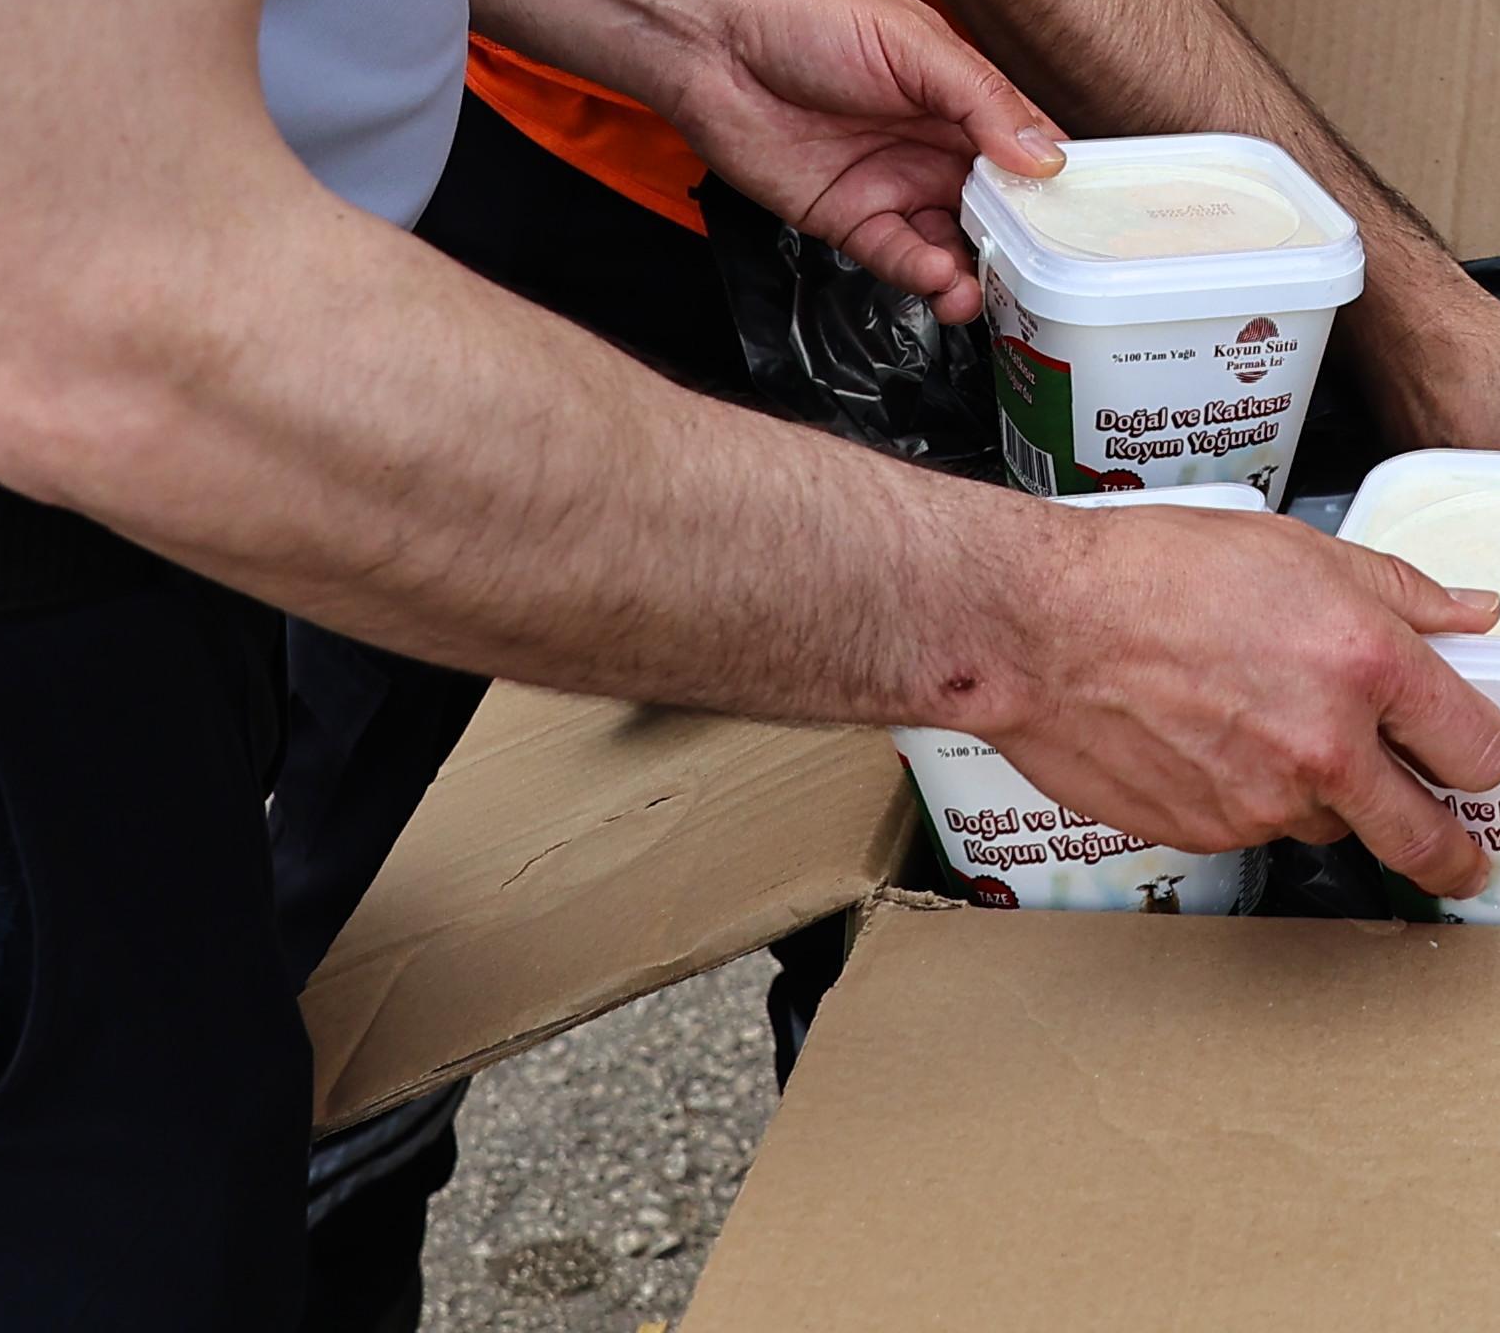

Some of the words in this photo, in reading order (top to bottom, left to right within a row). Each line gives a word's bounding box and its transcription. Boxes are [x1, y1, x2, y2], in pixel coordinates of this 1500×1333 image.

[1111, 352, 1141, 364] %100
[1144, 351, 1168, 362] Tam
[1169, 347, 1197, 362] Yağlı
[1213, 342, 1262, 361] Koyun
[1264, 337, 1299, 356] Sütü
[1225, 358, 1267, 372] Parmak
[1268, 355, 1285, 369] İzi
[1095, 408, 1168, 436] Doğal
[1171, 406, 1200, 425] ve
[1205, 392, 1293, 424] Katkısız
[1104, 435, 1184, 465] Koyun
[1187, 420, 1281, 458] Yoğurdu
[936, 746, 971, 758] %100
[1462, 800, 1495, 822] ve
[946, 807, 1019, 841] Doğal
[1023, 810, 1057, 832] ve
[965, 839, 1048, 870] Koyun
[977, 890, 1011, 907] TAZE
